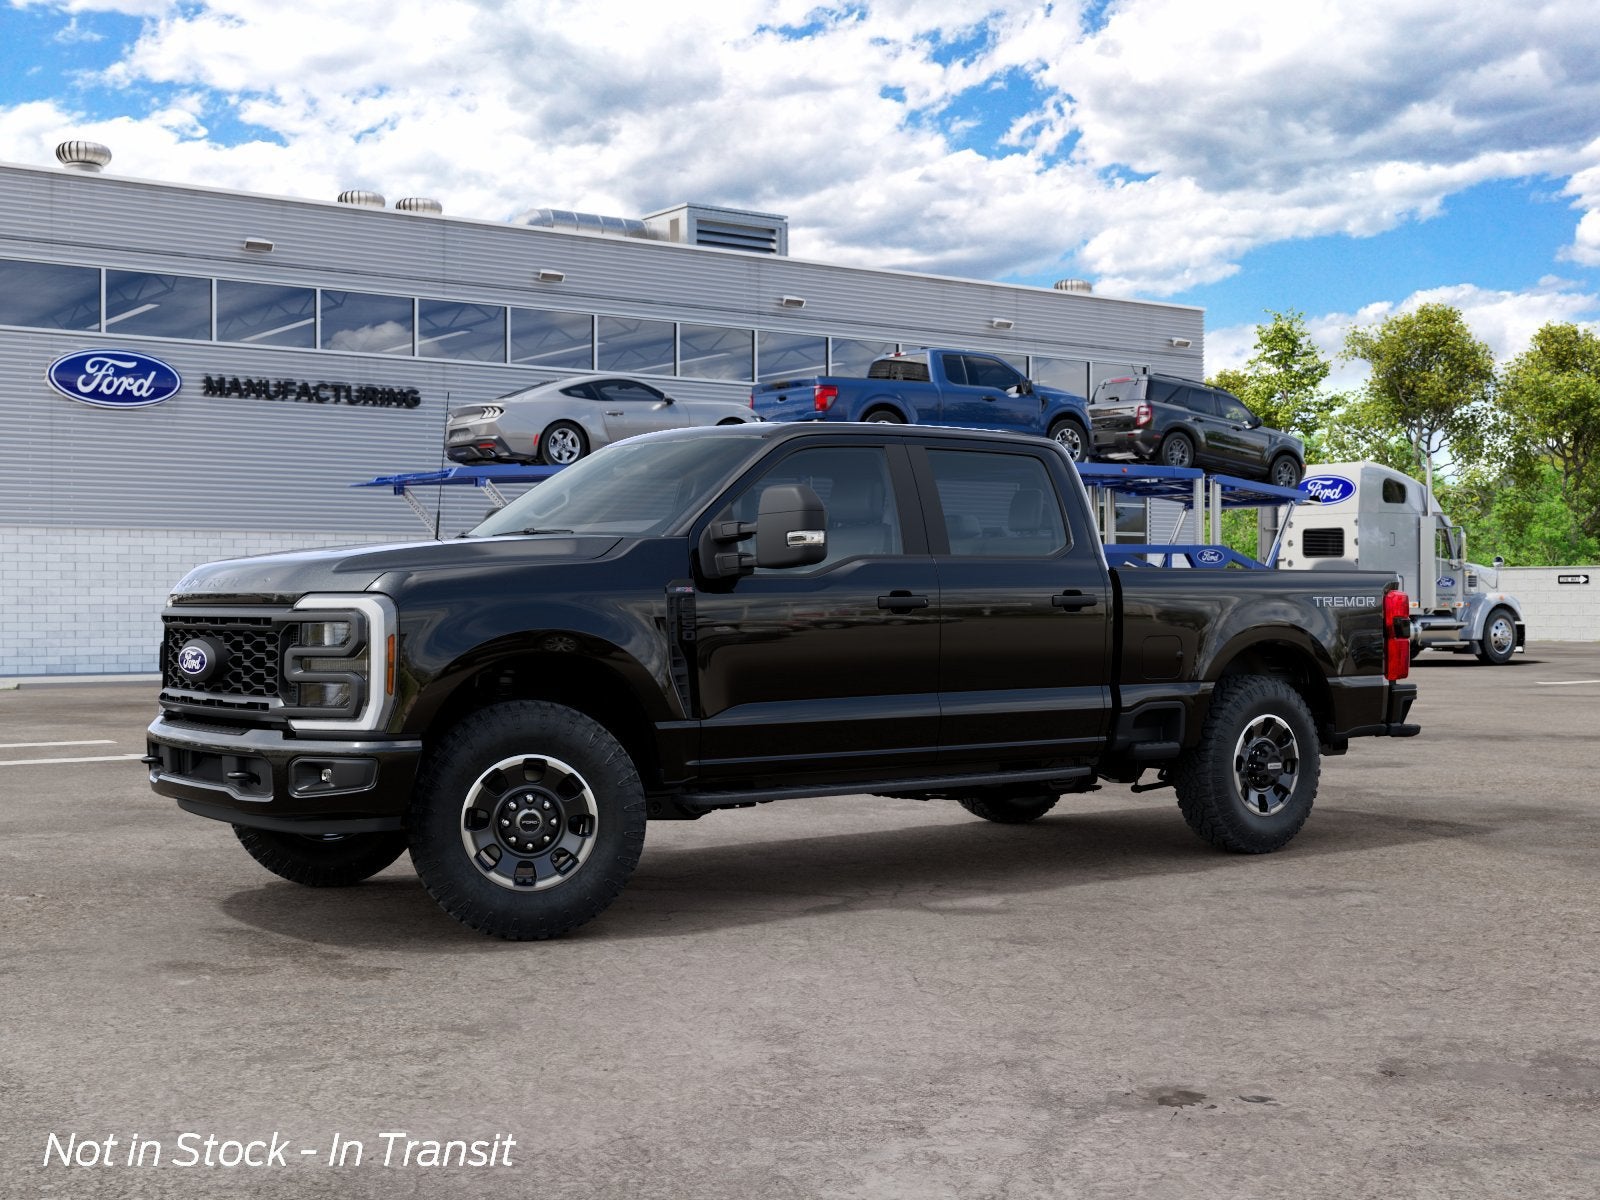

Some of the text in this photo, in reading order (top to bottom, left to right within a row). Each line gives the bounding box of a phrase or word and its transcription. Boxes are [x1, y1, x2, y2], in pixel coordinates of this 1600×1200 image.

[77, 357, 421, 409] Ford MANUFACTURING
[1307, 480, 1343, 500] Ford
[1312, 596, 1376, 608] TREMOR
[183, 650, 201, 670] Ford
